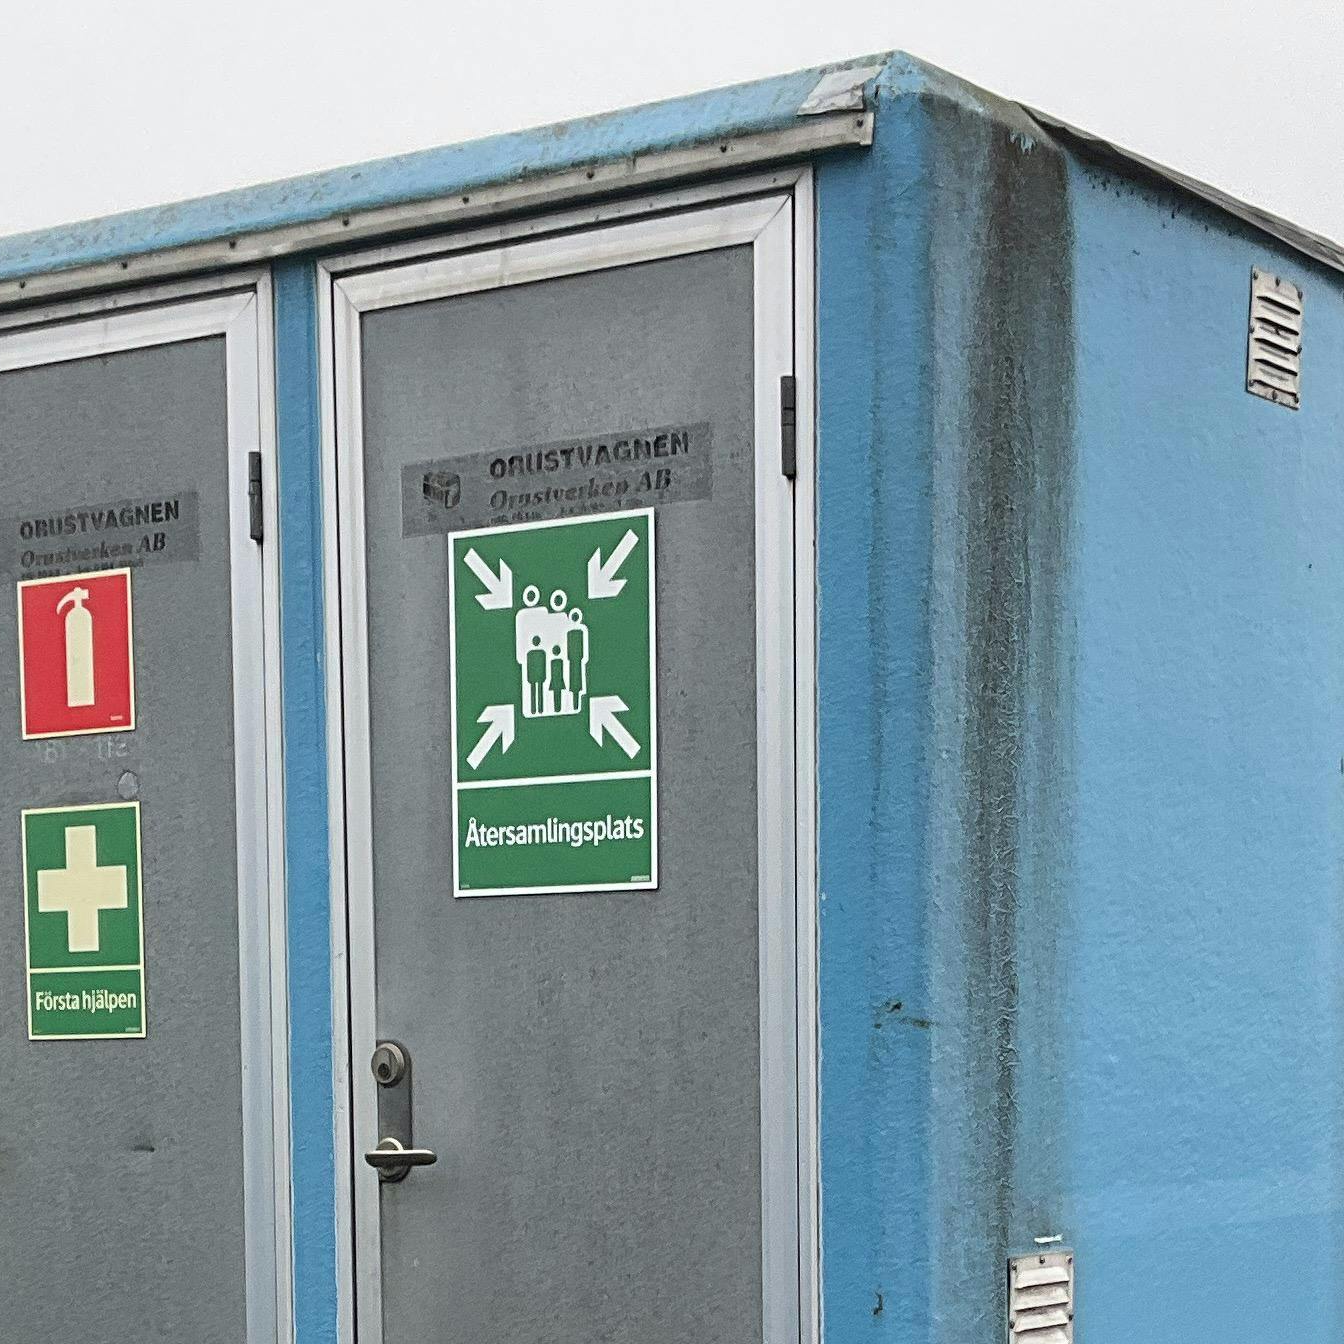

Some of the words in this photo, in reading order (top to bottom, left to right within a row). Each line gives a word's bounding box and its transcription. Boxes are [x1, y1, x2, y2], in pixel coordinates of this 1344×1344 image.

[19, 500, 179, 540] ORUSTVAGNEN
[137, 532, 167, 553] AB
[465, 814, 645, 848] Återsamlingsplats
[35, 990, 80, 1011] Första
[81, 989, 137, 1014] hjälpen
